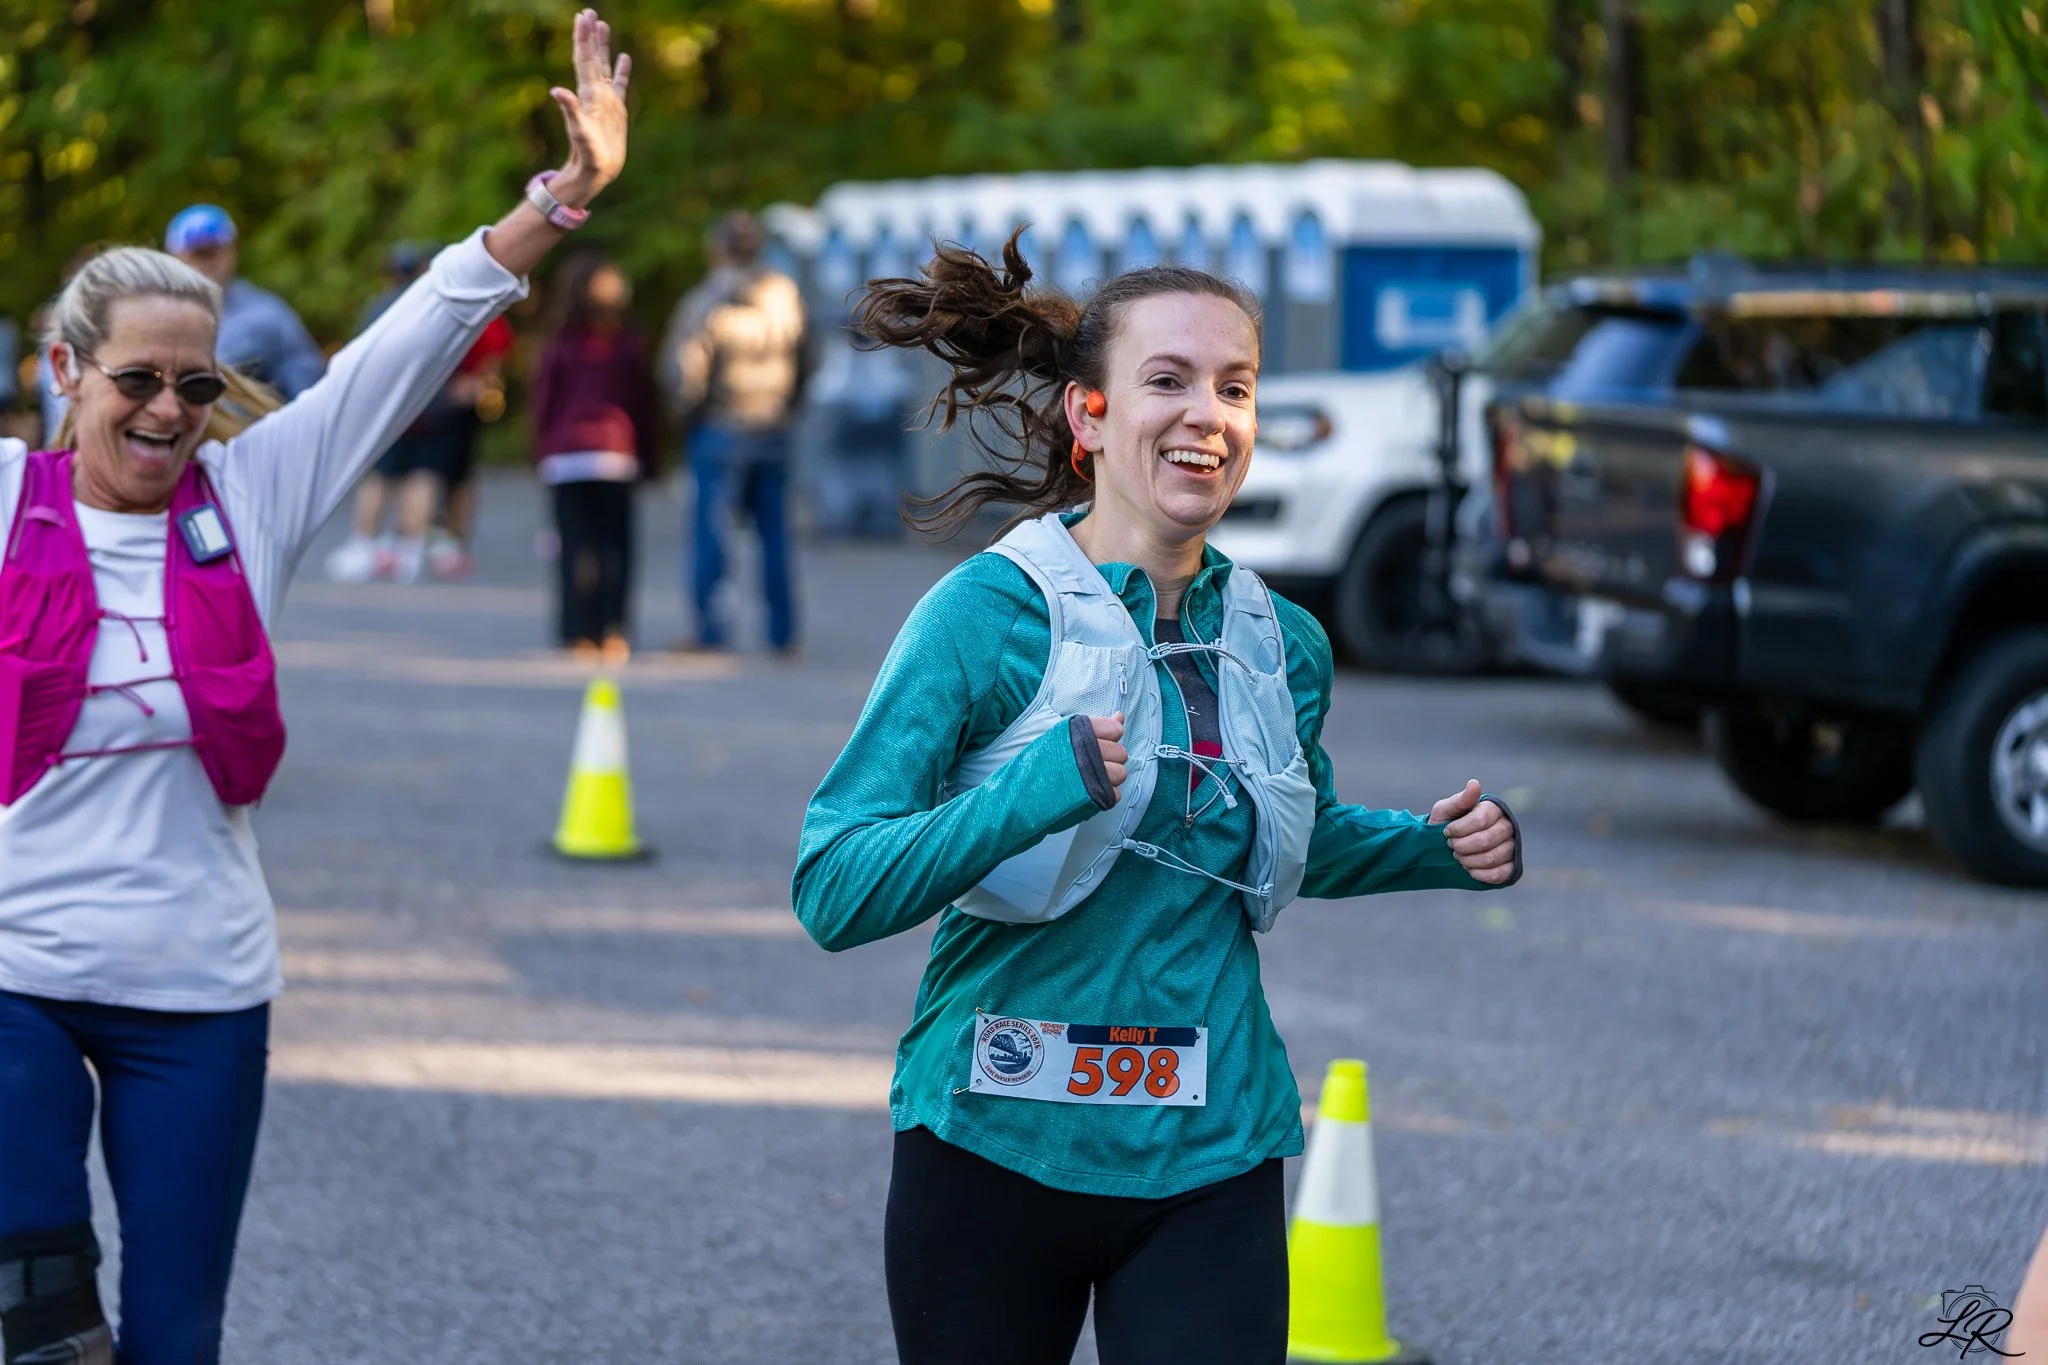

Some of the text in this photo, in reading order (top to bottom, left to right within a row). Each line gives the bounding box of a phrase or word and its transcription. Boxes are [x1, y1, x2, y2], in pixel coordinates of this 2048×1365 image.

[981, 1027, 994, 1043] ROAD
[995, 1020, 1010, 1030] RACE
[1011, 1020, 1031, 1035] SERIES
[1109, 1026, 1158, 1045] Kelly T
[1067, 1046, 1180, 1098] 598
